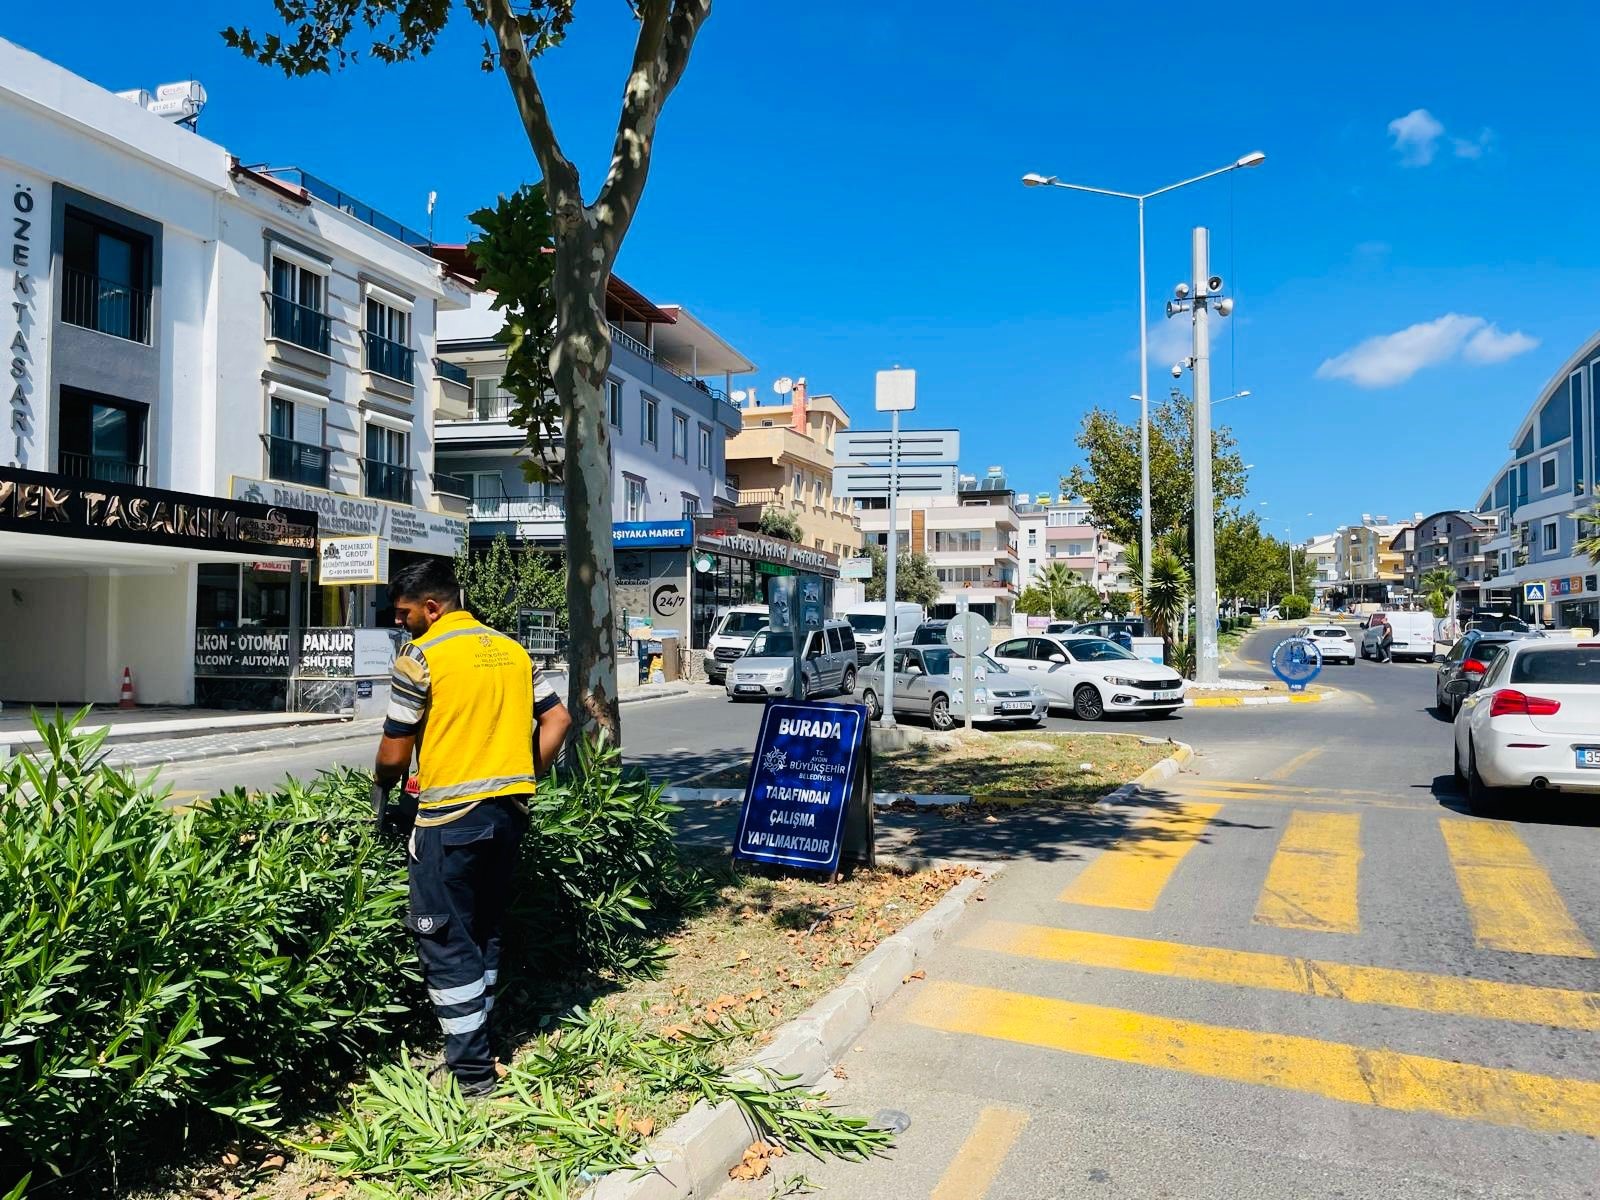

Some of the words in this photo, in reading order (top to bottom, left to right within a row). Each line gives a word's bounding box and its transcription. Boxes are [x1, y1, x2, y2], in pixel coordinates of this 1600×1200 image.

[80, 491, 237, 541] TASARIM
[340, 501, 380, 521] GROUP
[649, 528, 685, 538] MARKET
[791, 547, 828, 567] MARKET
[659, 595, 685, 608] 24/7
[302, 633, 354, 651] PANJUR
[303, 656, 353, 667] SHUTTER
[778, 718, 841, 740] BURADA
[789, 760, 846, 774] BÜYÜKŞEHİR
[1586, 751, 1600, 763] 35
[766, 785, 831, 805] TARAFINDAN
[769, 809, 815, 829] ÇALIŞMA
[747, 830, 830, 854] YAPILMAKTADIR
